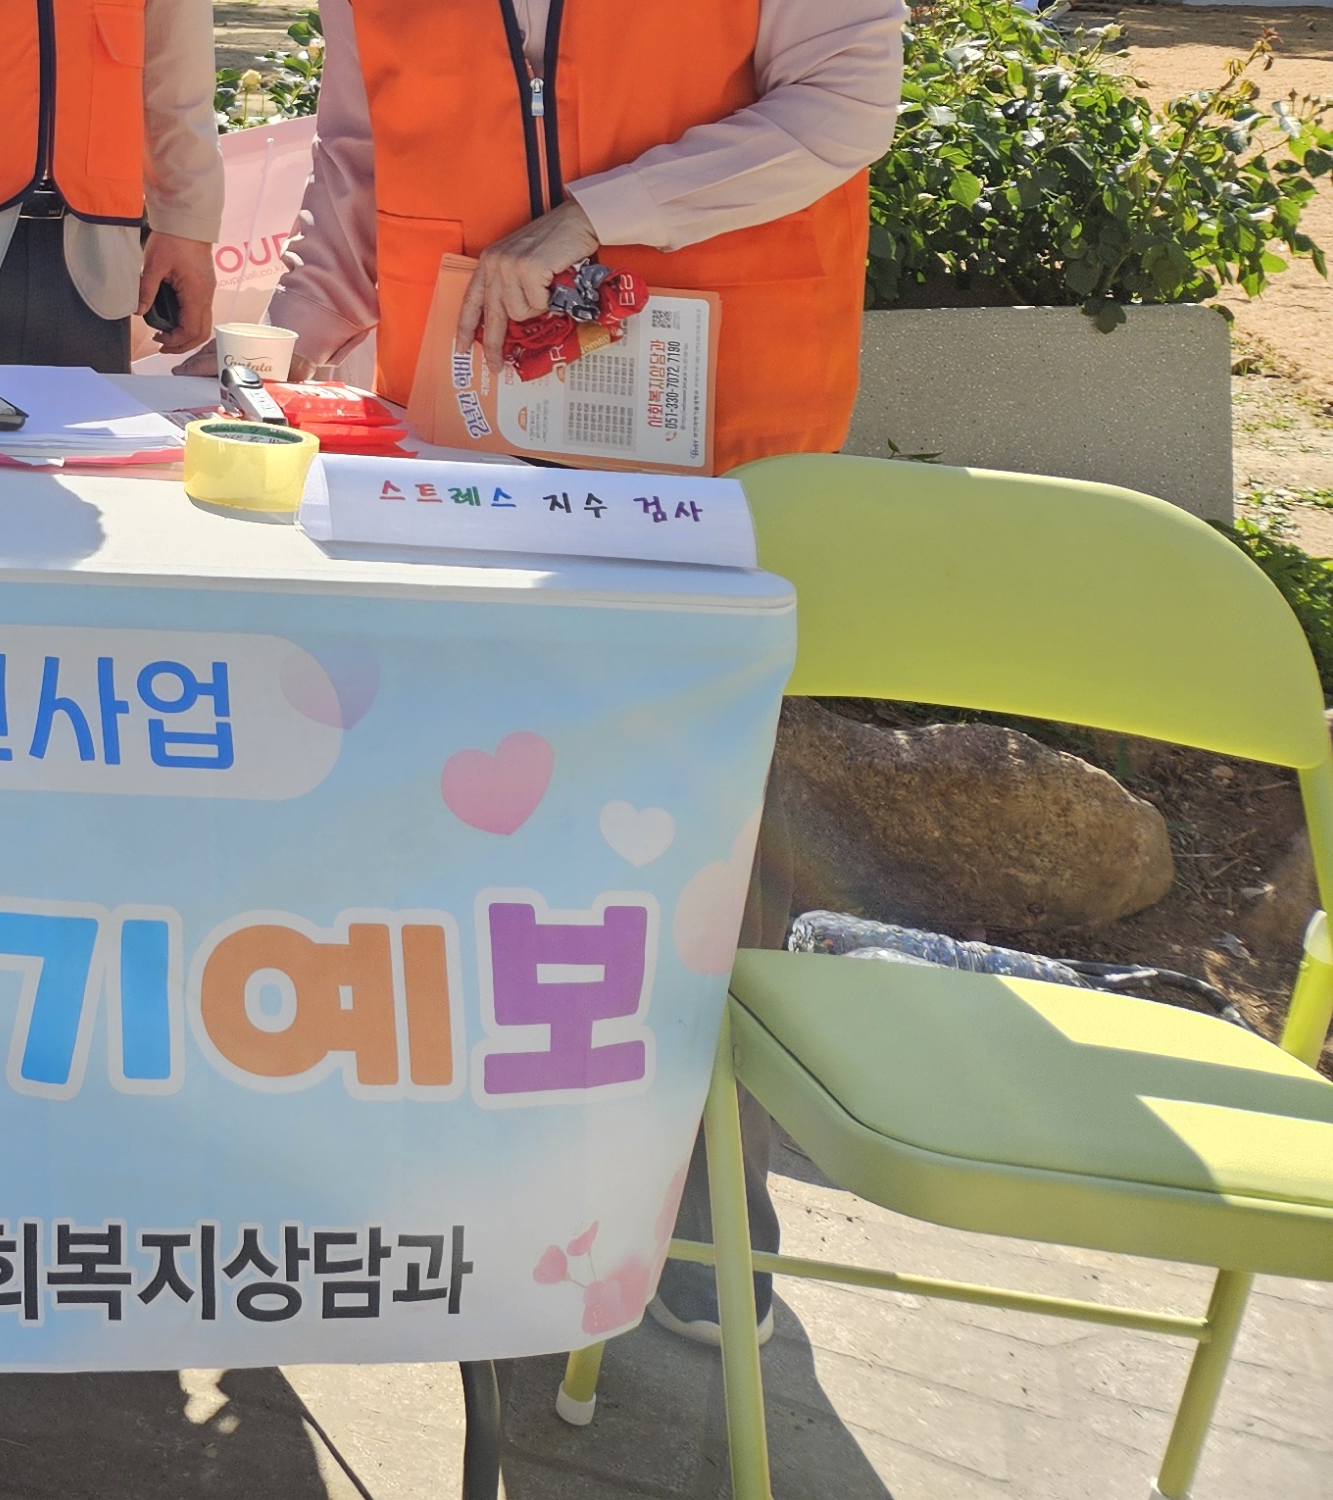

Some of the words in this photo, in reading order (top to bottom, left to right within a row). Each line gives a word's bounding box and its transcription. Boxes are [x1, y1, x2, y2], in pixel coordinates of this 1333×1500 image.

[217, 265, 285, 288] oupmall.co.kr
[452, 348, 472, 388] 학비
[667, 340, 681, 363] 7190
[647, 340, 666, 428] 사회복지상담과
[457, 391, 491, 438] 2년간
[379, 479, 517, 510] 스트레스
[544, 491, 607, 519] 지수
[633, 494, 704, 523] 검사
